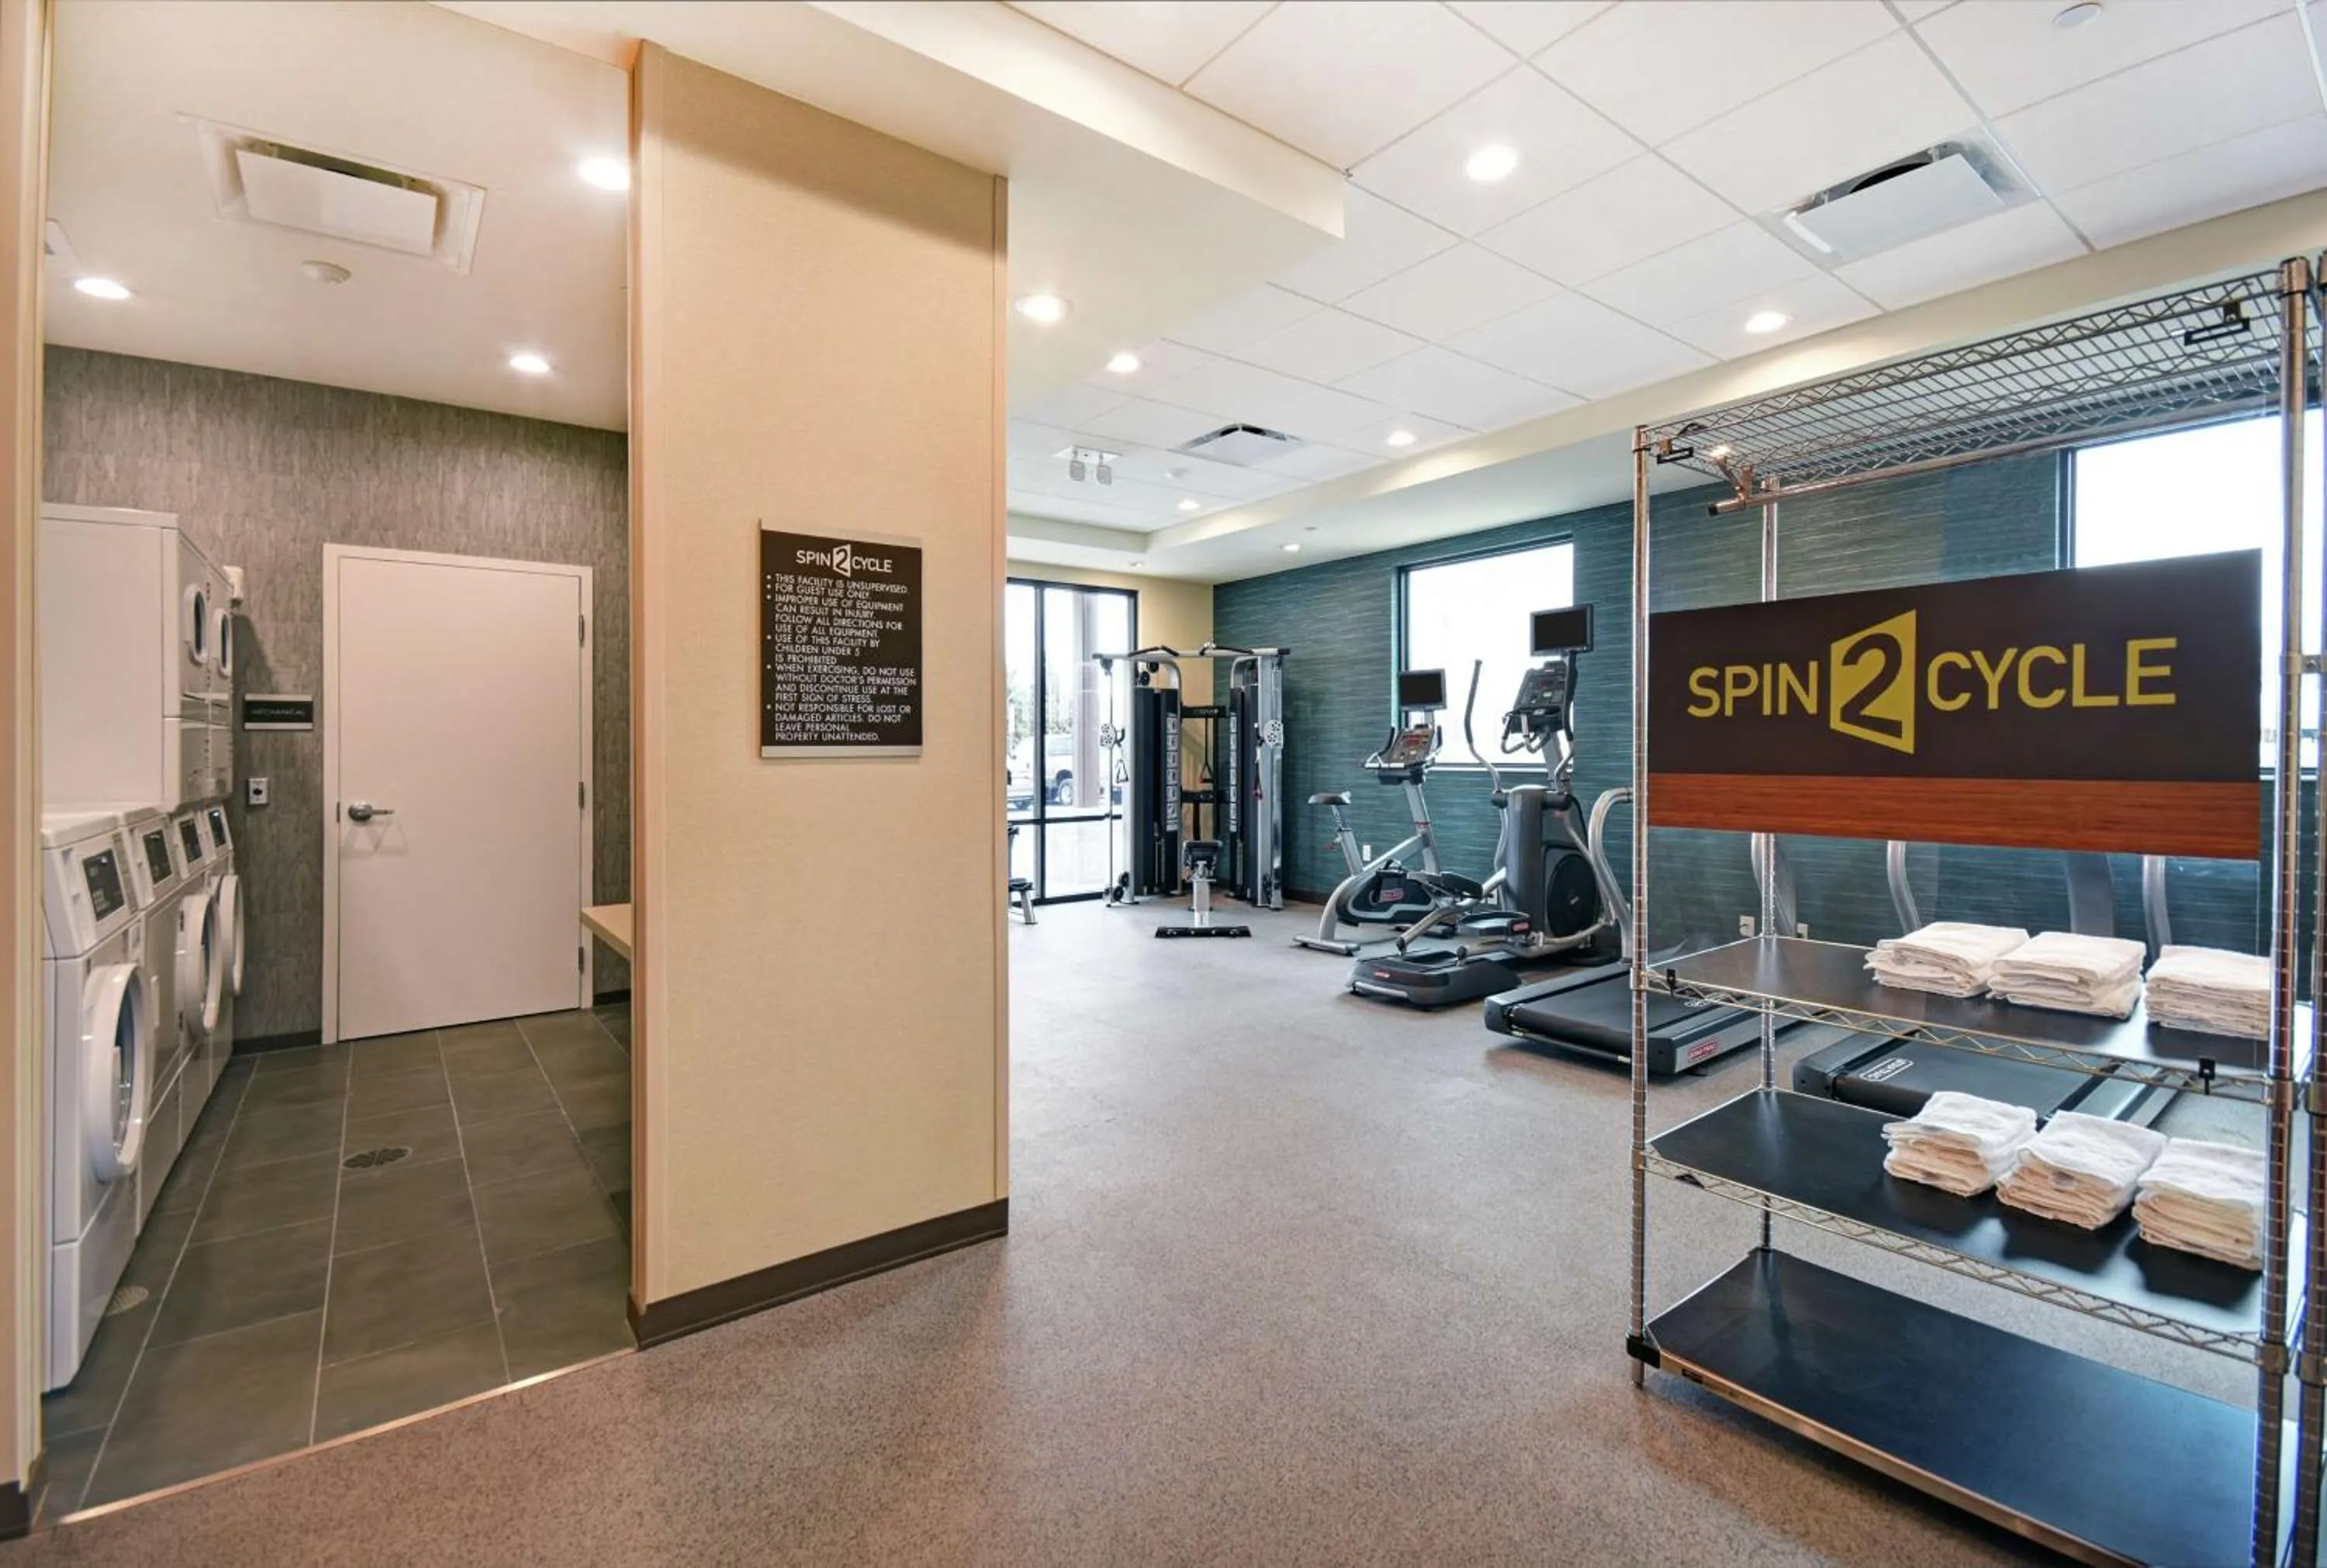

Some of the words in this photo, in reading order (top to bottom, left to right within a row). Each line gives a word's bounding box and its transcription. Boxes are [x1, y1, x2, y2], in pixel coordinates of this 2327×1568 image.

[796, 550, 831, 567] SPIN
[835, 547, 849, 574] 2
[852, 556, 893, 573] CYCLE
[776, 573, 794, 583] THIS
[798, 575, 833, 587] FACILITY
[836, 579, 844, 588] IS
[776, 582, 793, 592] FOR
[797, 585, 825, 596] GUEST
[828, 589, 844, 597] USE
[776, 595, 818, 606] IMPROPER
[822, 598, 838, 607] USE
[841, 599, 852, 608] OF
[856, 600, 904, 612] EQUIPMENT
[776, 603, 796, 613] CAN
[800, 605, 828, 615] RESULT
[776, 614, 813, 624] FOLLOW
[816, 616, 830, 626] ALL
[833, 618, 883, 630] DIRECTIONS
[886, 621, 902, 630] FOR
[776, 624, 792, 633] USE
[795, 625, 807, 634] OF
[811, 627, 825, 635] ALL
[776, 634, 792, 643] USE
[795, 635, 807, 644] OF
[812, 636, 830, 644] THIS
[833, 637, 866, 647] FACILITY
[870, 640, 880, 648] BY
[776, 644, 818, 654] CHILDREN
[821, 647, 851, 655] UNDER
[776, 654, 784, 662] IS
[776, 663, 804, 672] WHEN
[863, 667, 876, 675] DO
[879, 668, 897, 676] NOT
[900, 668, 915, 677] USE
[776, 674, 817, 682] WITHOUT
[867, 676, 916, 686] PERMISSION
[1687, 661, 1817, 718] SPIN
[1838, 630, 1905, 741] 2
[1928, 637, 2177, 711] CYCLE
[776, 683, 796, 692] AND
[800, 684, 859, 694] DISCONTINUE
[862, 686, 877, 694] USE
[880, 686, 890, 695] AT
[776, 693, 797, 702] FIRST
[776, 703, 795, 712] NOT
[798, 703, 854, 713] RESPONSIBLE
[877, 705, 897, 713] LOST
[899, 705, 911, 713] OR
[776, 713, 821, 722] DAMAGED
[868, 714, 881, 723] DO
[776, 723, 802, 731] LEAVE
[776, 732, 818, 741] PROPERTY
